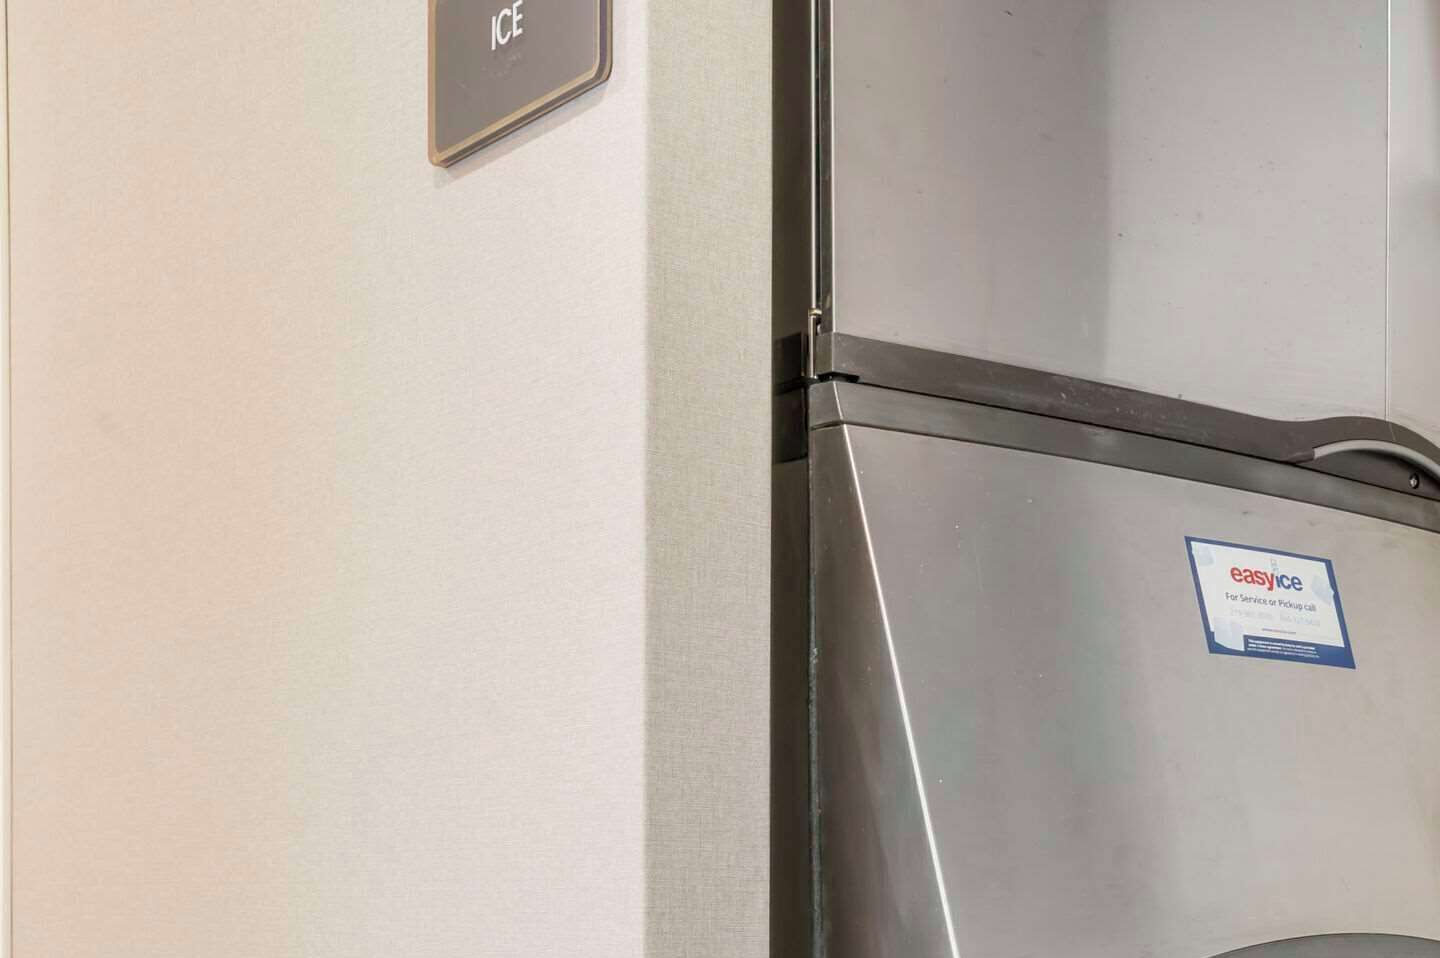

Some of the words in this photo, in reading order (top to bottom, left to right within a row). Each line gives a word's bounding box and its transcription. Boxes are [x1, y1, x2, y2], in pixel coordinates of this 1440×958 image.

[491, 0, 523, 51] ICE
[1225, 592, 1238, 601] For
[1239, 593, 1268, 605] Service
[1278, 599, 1303, 611] Pickup
[1304, 604, 1317, 612] call
